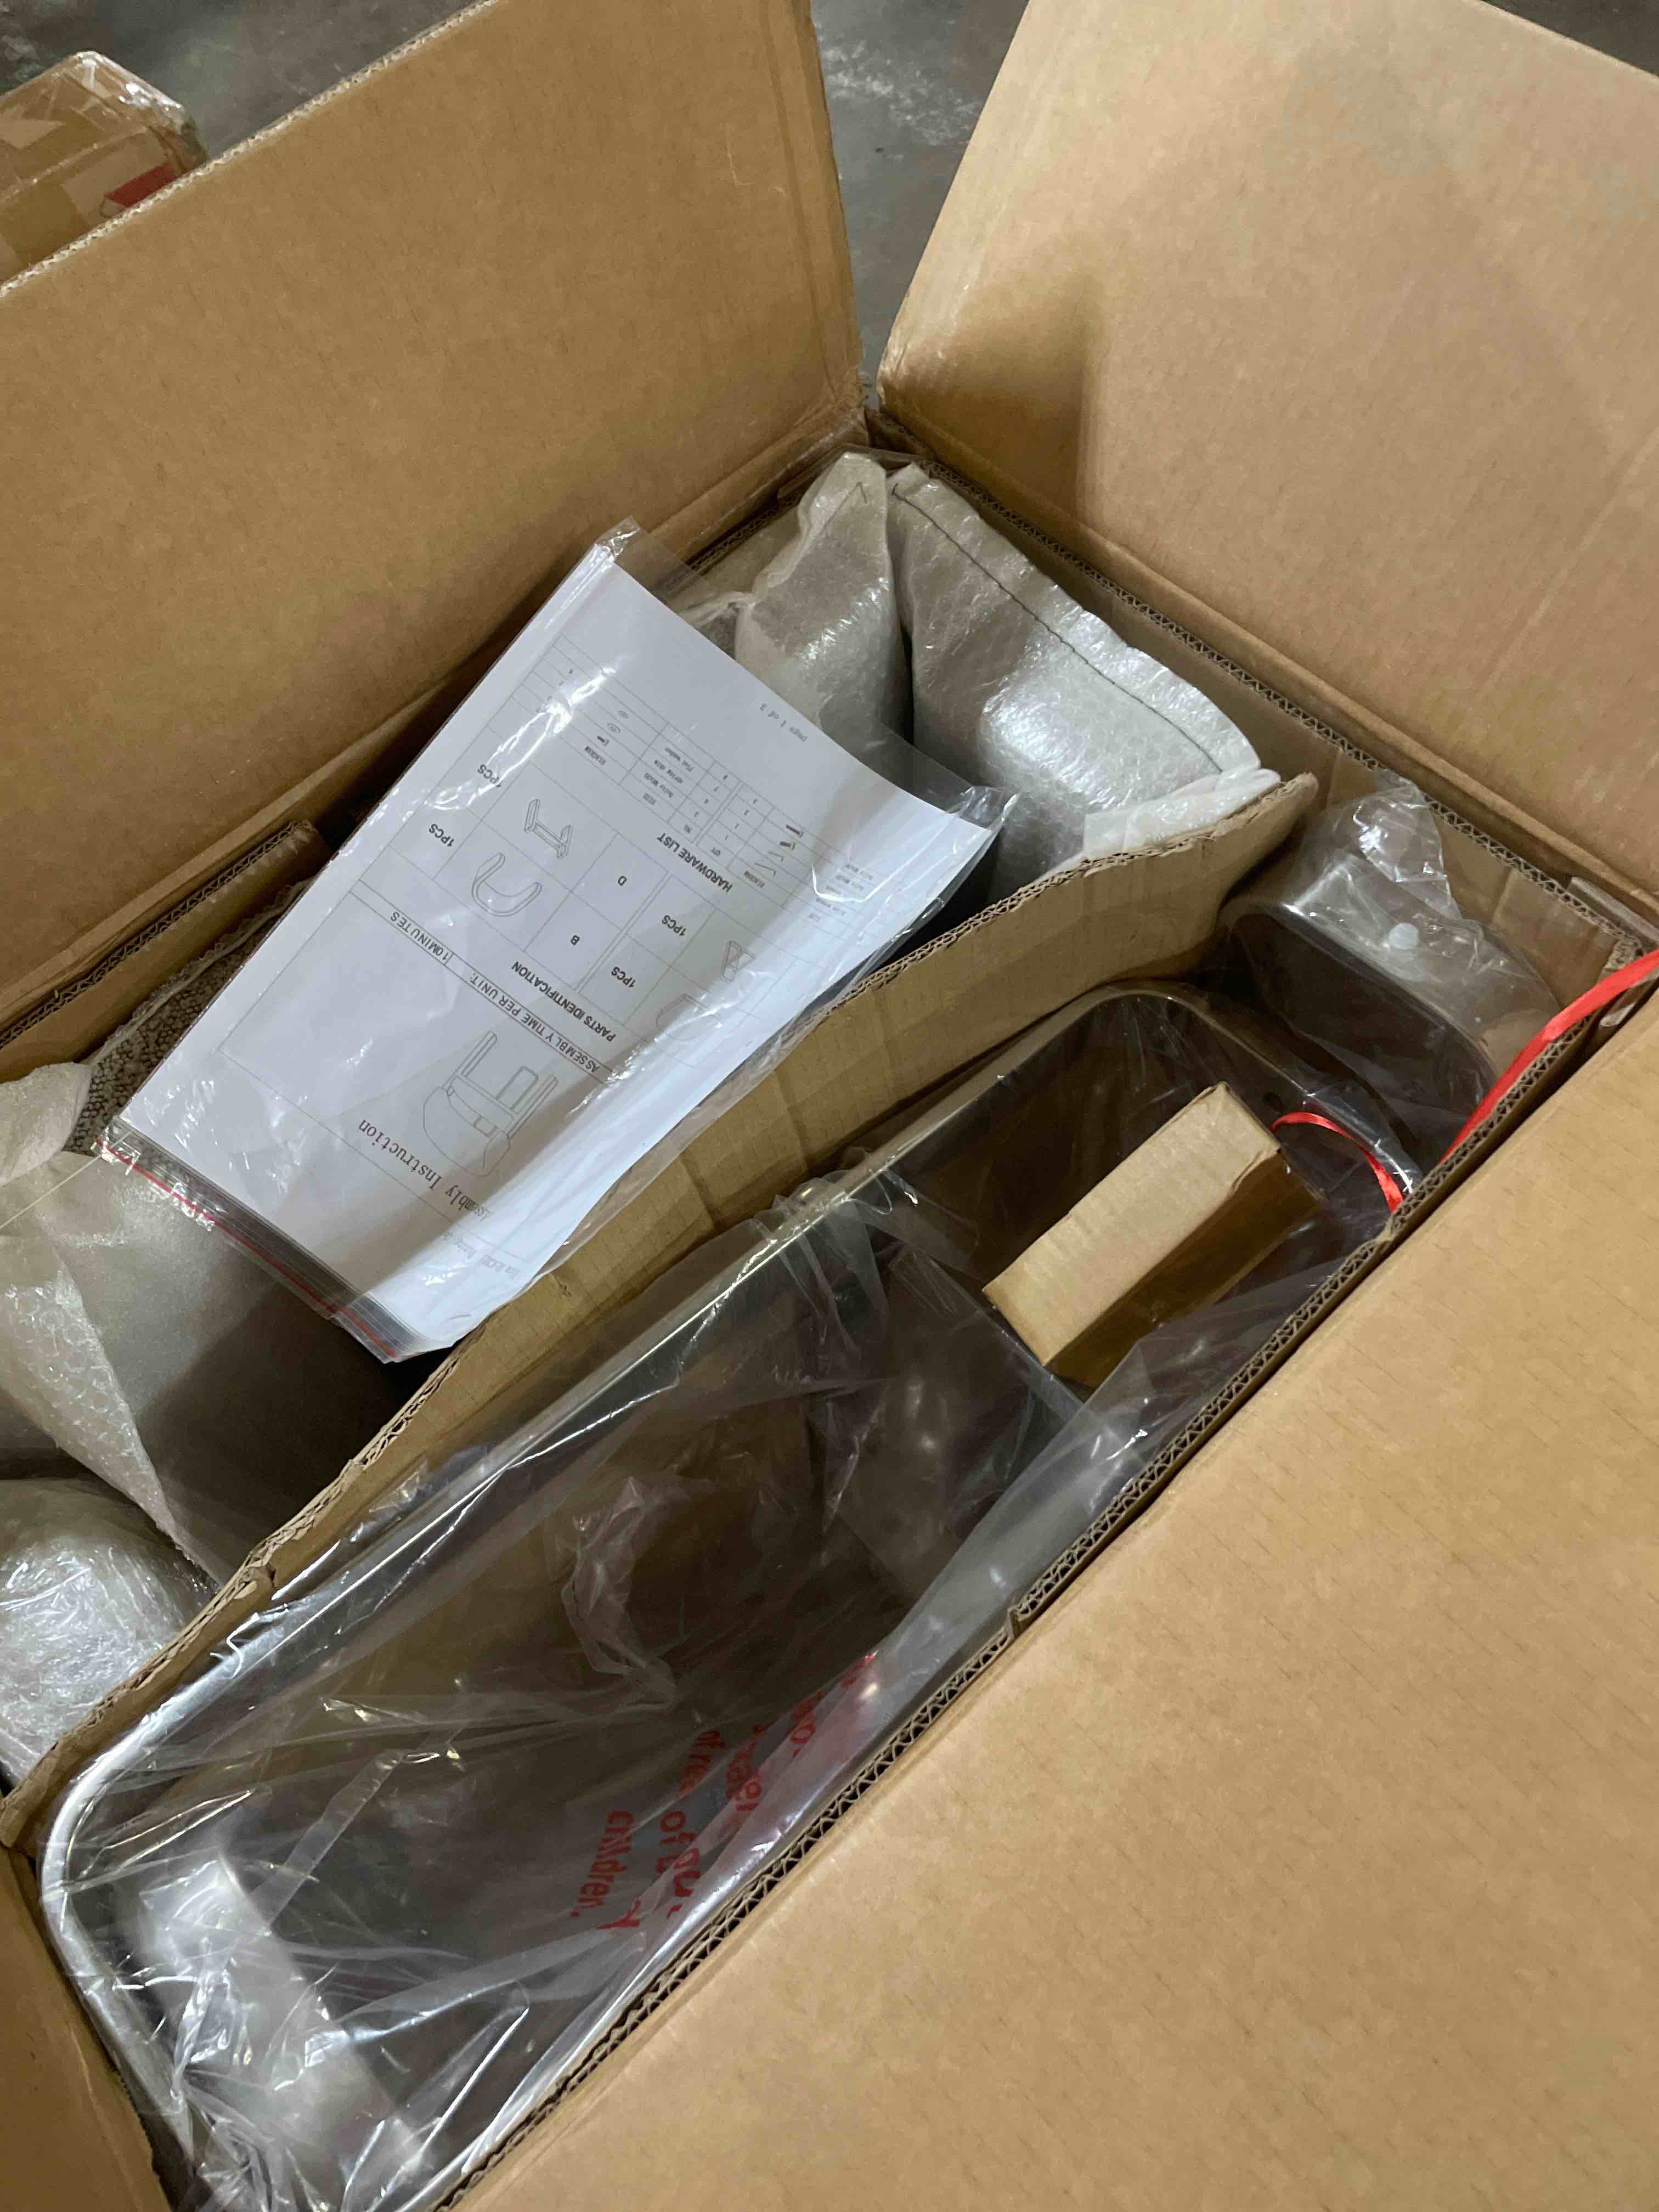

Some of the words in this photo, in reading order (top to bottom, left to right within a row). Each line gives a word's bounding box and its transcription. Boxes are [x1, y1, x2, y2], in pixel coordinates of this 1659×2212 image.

[428, 823, 454, 847] 1PCS
[657, 832, 680, 853] LIST
[617, 875, 627, 886] D
[678, 848, 732, 891] HARDWARE
[661, 915, 686, 936] 1PCS
[570, 935, 580, 945] B
[470, 973, 498, 999] UNIT:
[611, 966, 635, 988] 1PCS
[511, 962, 584, 1019] IDENTIFICATION
[498, 995, 521, 1016] PER
[521, 1013, 545, 1035] TIME
[583, 1015, 616, 1041] PARTS
[545, 1033, 600, 1072] ASSEMBLY
[359, 1120, 441, 1188] Instruction
